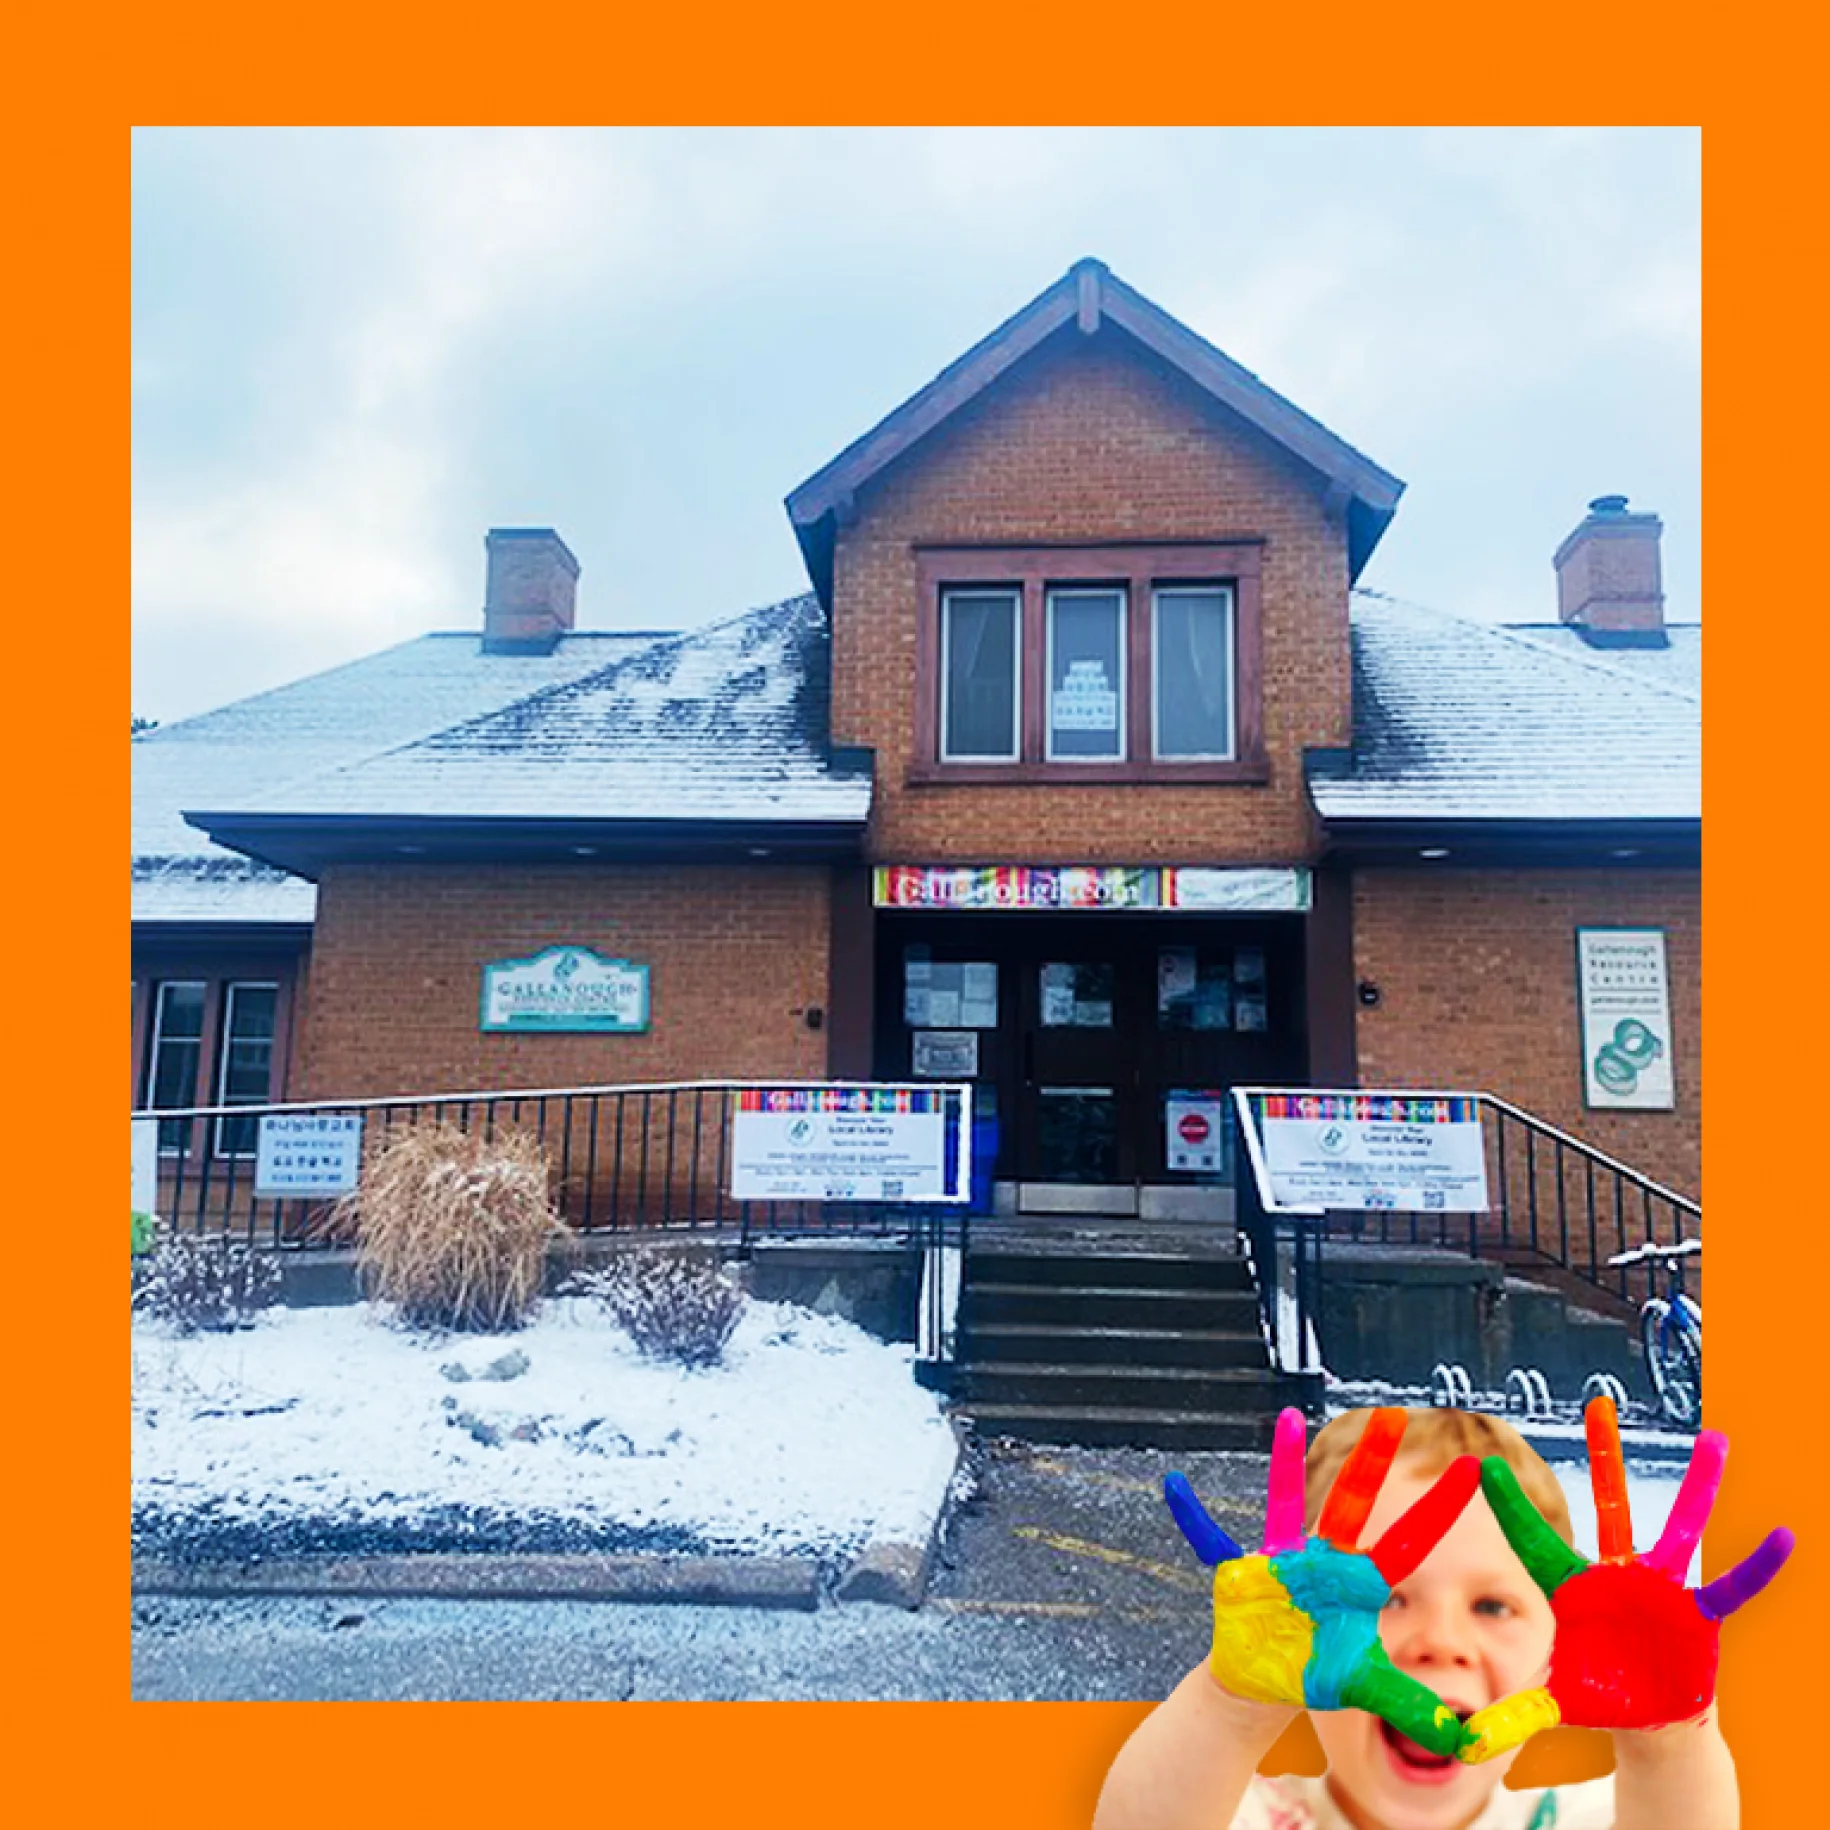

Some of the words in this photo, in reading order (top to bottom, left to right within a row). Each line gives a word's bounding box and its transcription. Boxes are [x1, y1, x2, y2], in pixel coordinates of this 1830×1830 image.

[828, 1126, 855, 1134] Local
[859, 1126, 893, 1135] Library
[1362, 1133, 1391, 1143] Local
[1394, 1134, 1432, 1146] Library
